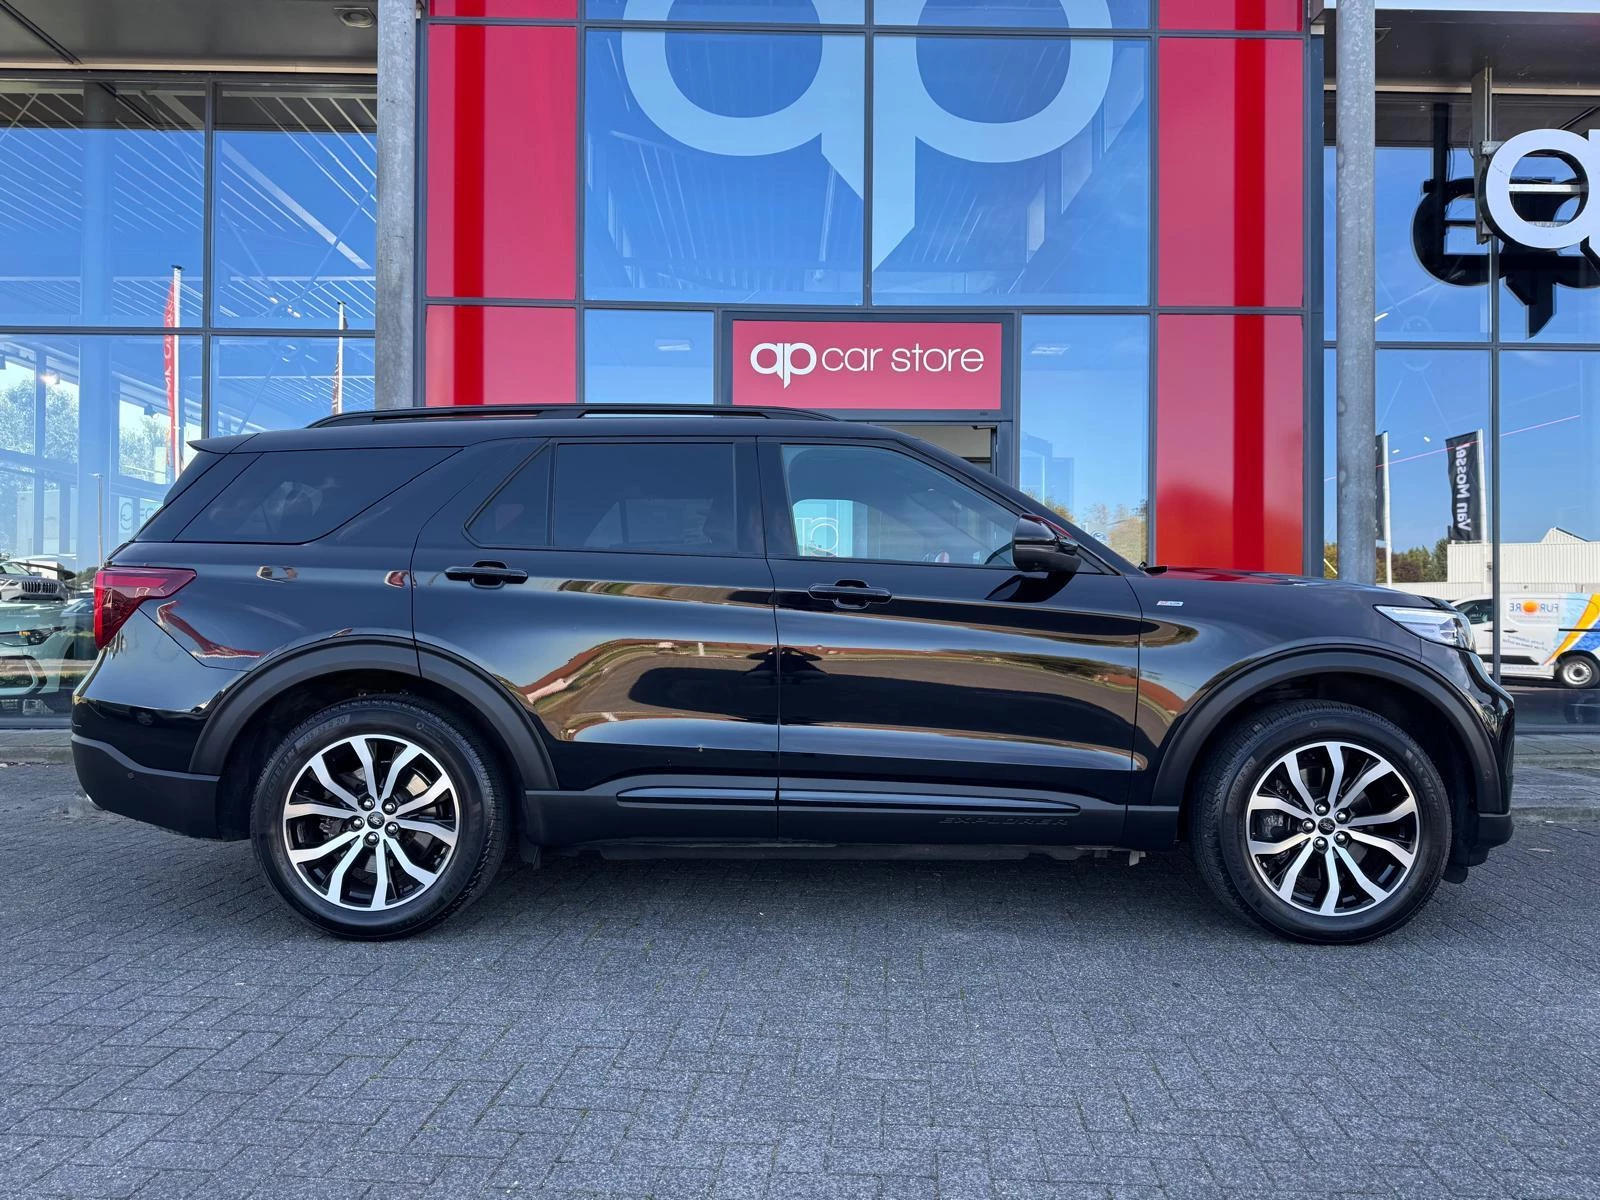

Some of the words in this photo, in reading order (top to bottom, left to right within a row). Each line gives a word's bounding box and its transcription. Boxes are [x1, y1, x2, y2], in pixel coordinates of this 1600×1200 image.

[821, 347, 884, 373] car
[891, 343, 985, 373] store
[938, 817, 1069, 826] EXPLORER
